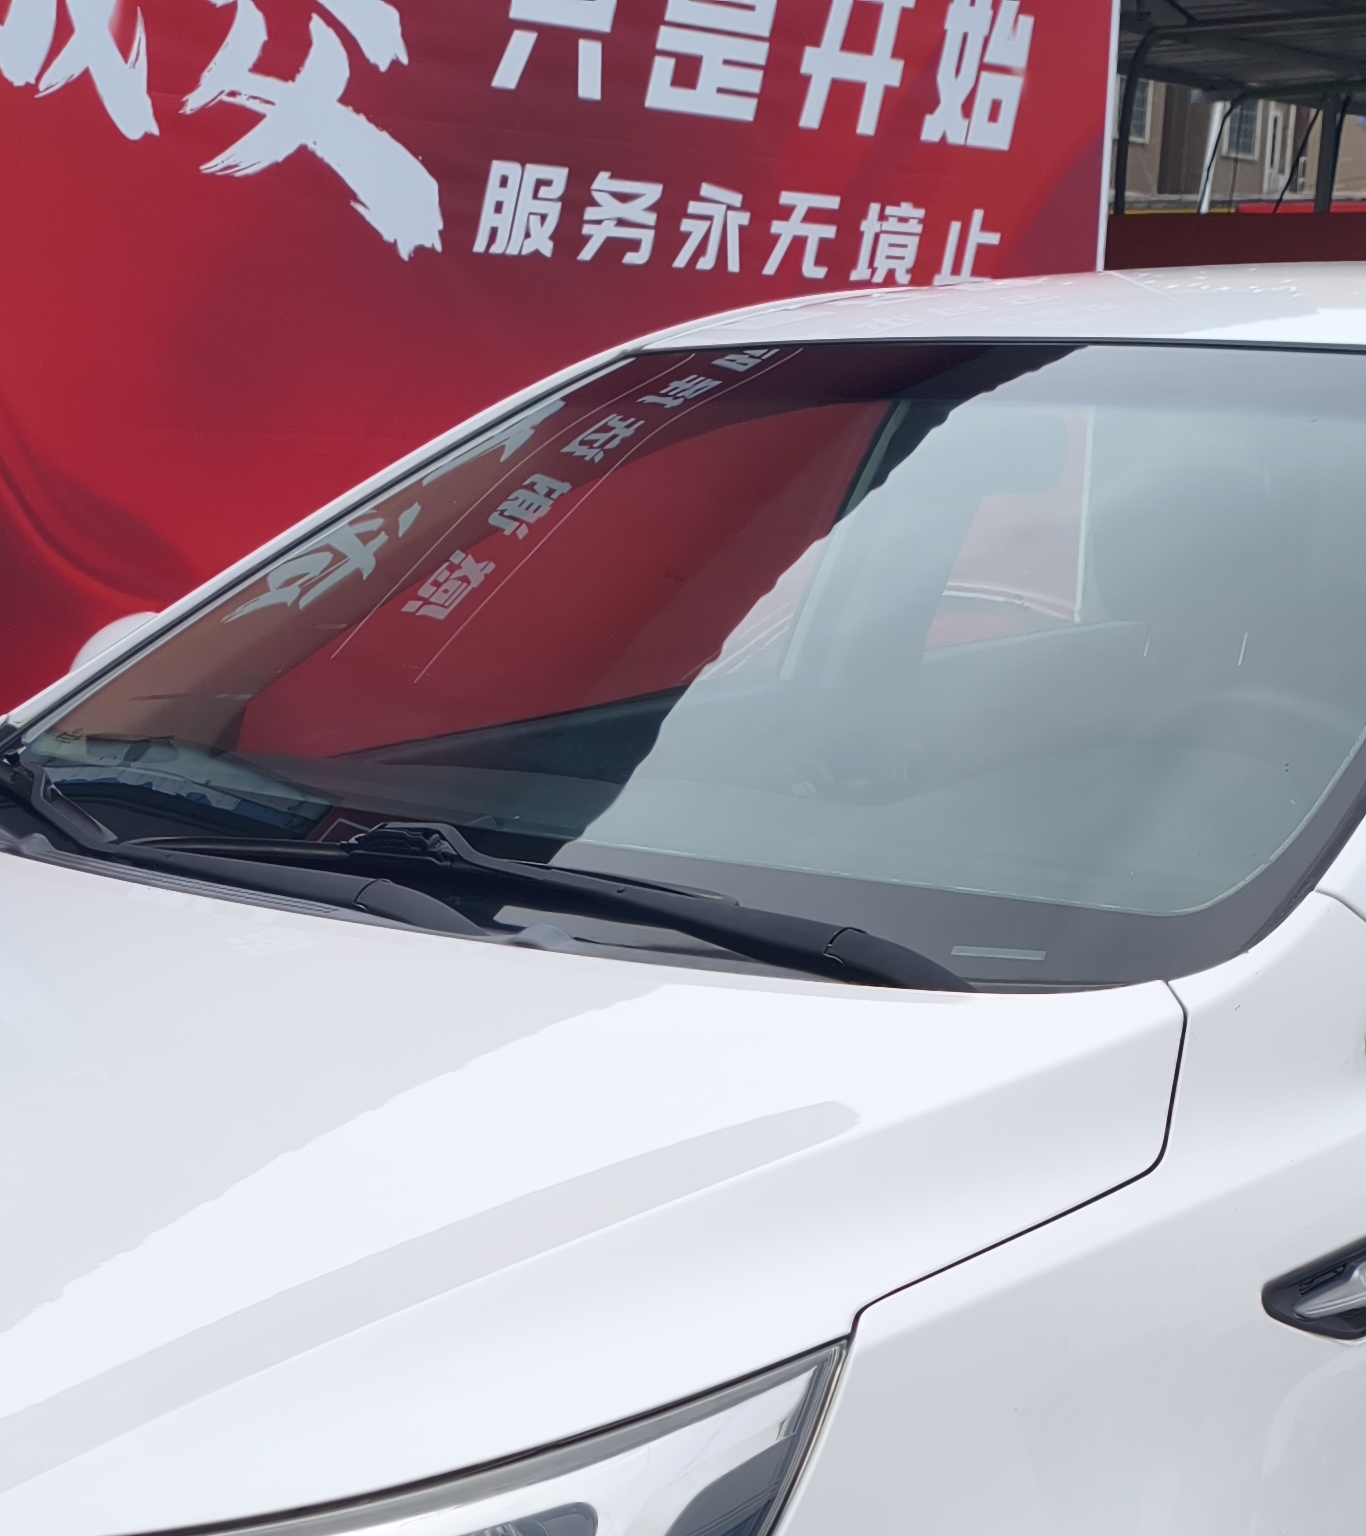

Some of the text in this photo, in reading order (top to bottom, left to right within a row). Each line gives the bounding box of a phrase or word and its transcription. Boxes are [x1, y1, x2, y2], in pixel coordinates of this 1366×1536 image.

[473, 160, 1002, 286] 服务永无境止
